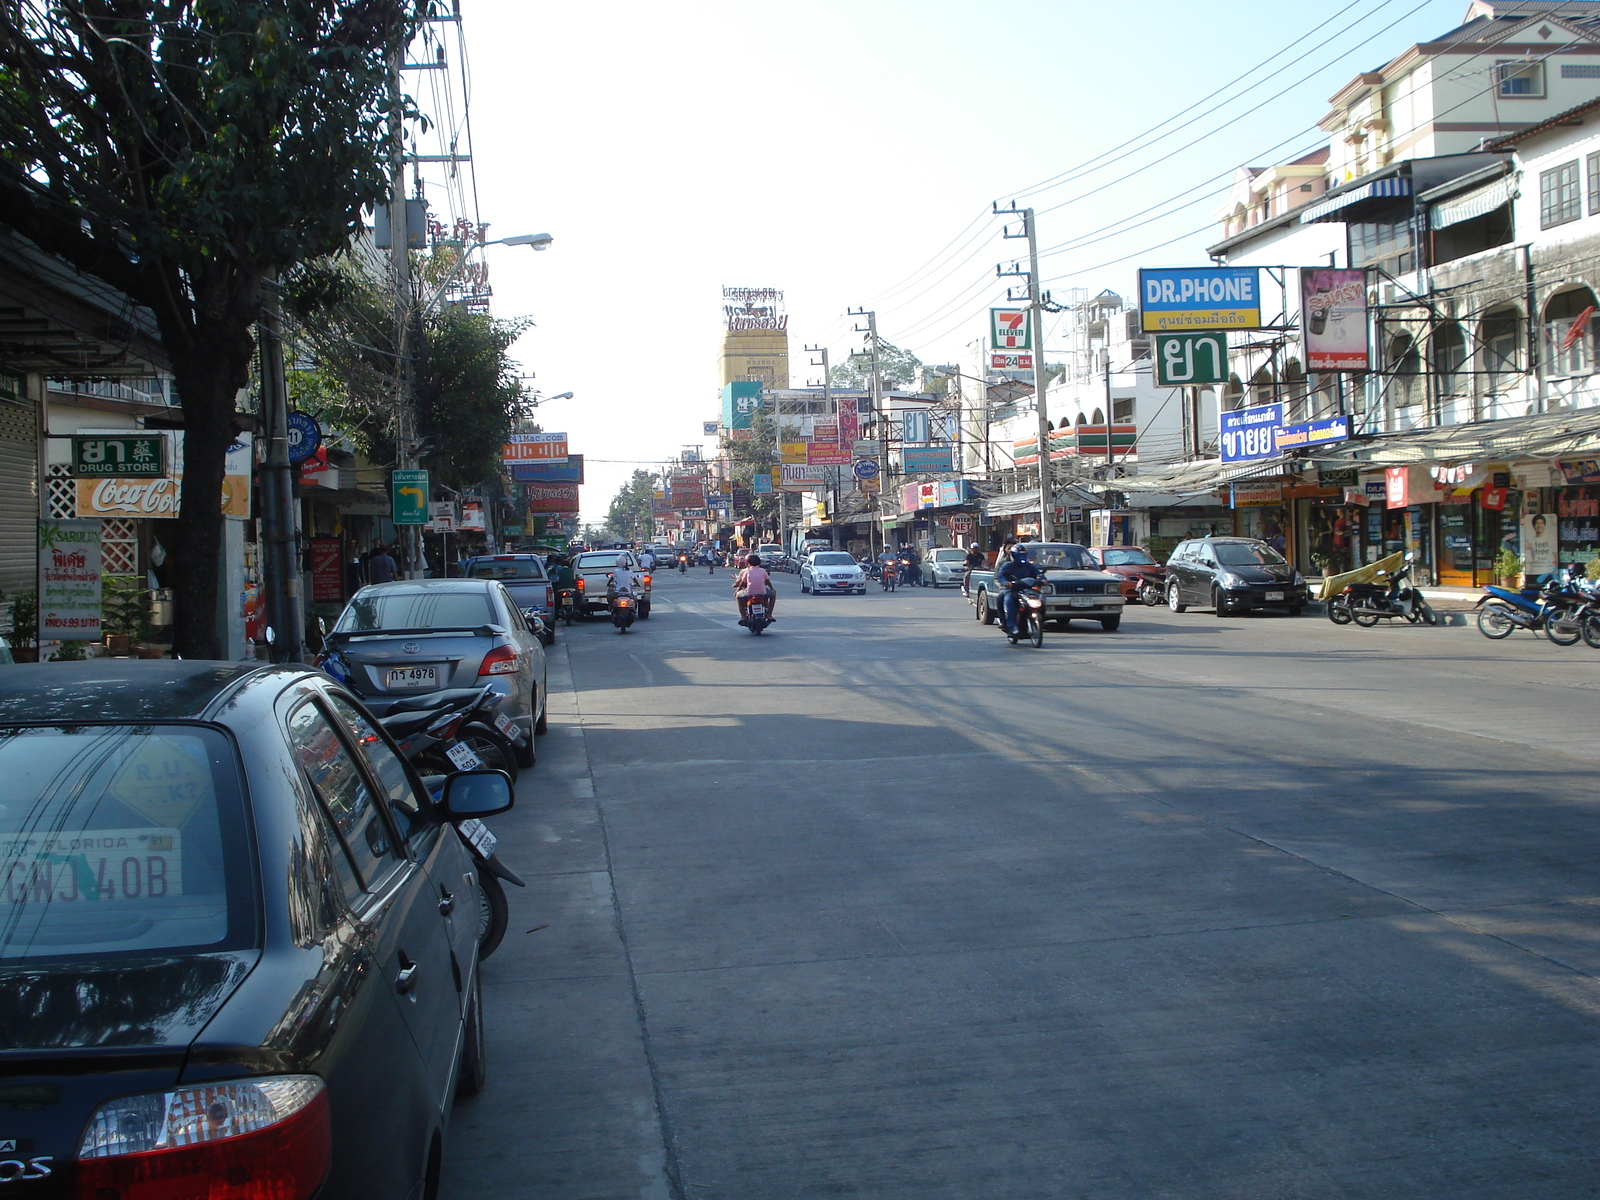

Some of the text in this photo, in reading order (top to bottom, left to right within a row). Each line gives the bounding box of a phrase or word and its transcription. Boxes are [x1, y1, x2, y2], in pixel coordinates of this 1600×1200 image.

[1146, 277, 1253, 303] DR.PHONE
[1158, 312, 1246, 329] ศูนย์ซ่อมมือถือ
[1006, 356, 1018, 366] 24
[1163, 338, 1222, 381] ยา
[905, 411, 928, 441] ยา
[288, 431, 298, 443] 11
[510, 434, 564, 443] 41Mac.com
[82, 440, 153, 463] ยา 藥
[79, 462, 158, 473] DRUG STORE
[91, 478, 182, 513] Coca-Col
[954, 523, 971, 531] NET
[409, 668, 434, 680] 4978
[46, 837, 128, 851] FLORIDA
[151, 837, 163, 846] 91
[98, 855, 168, 901] 40B
